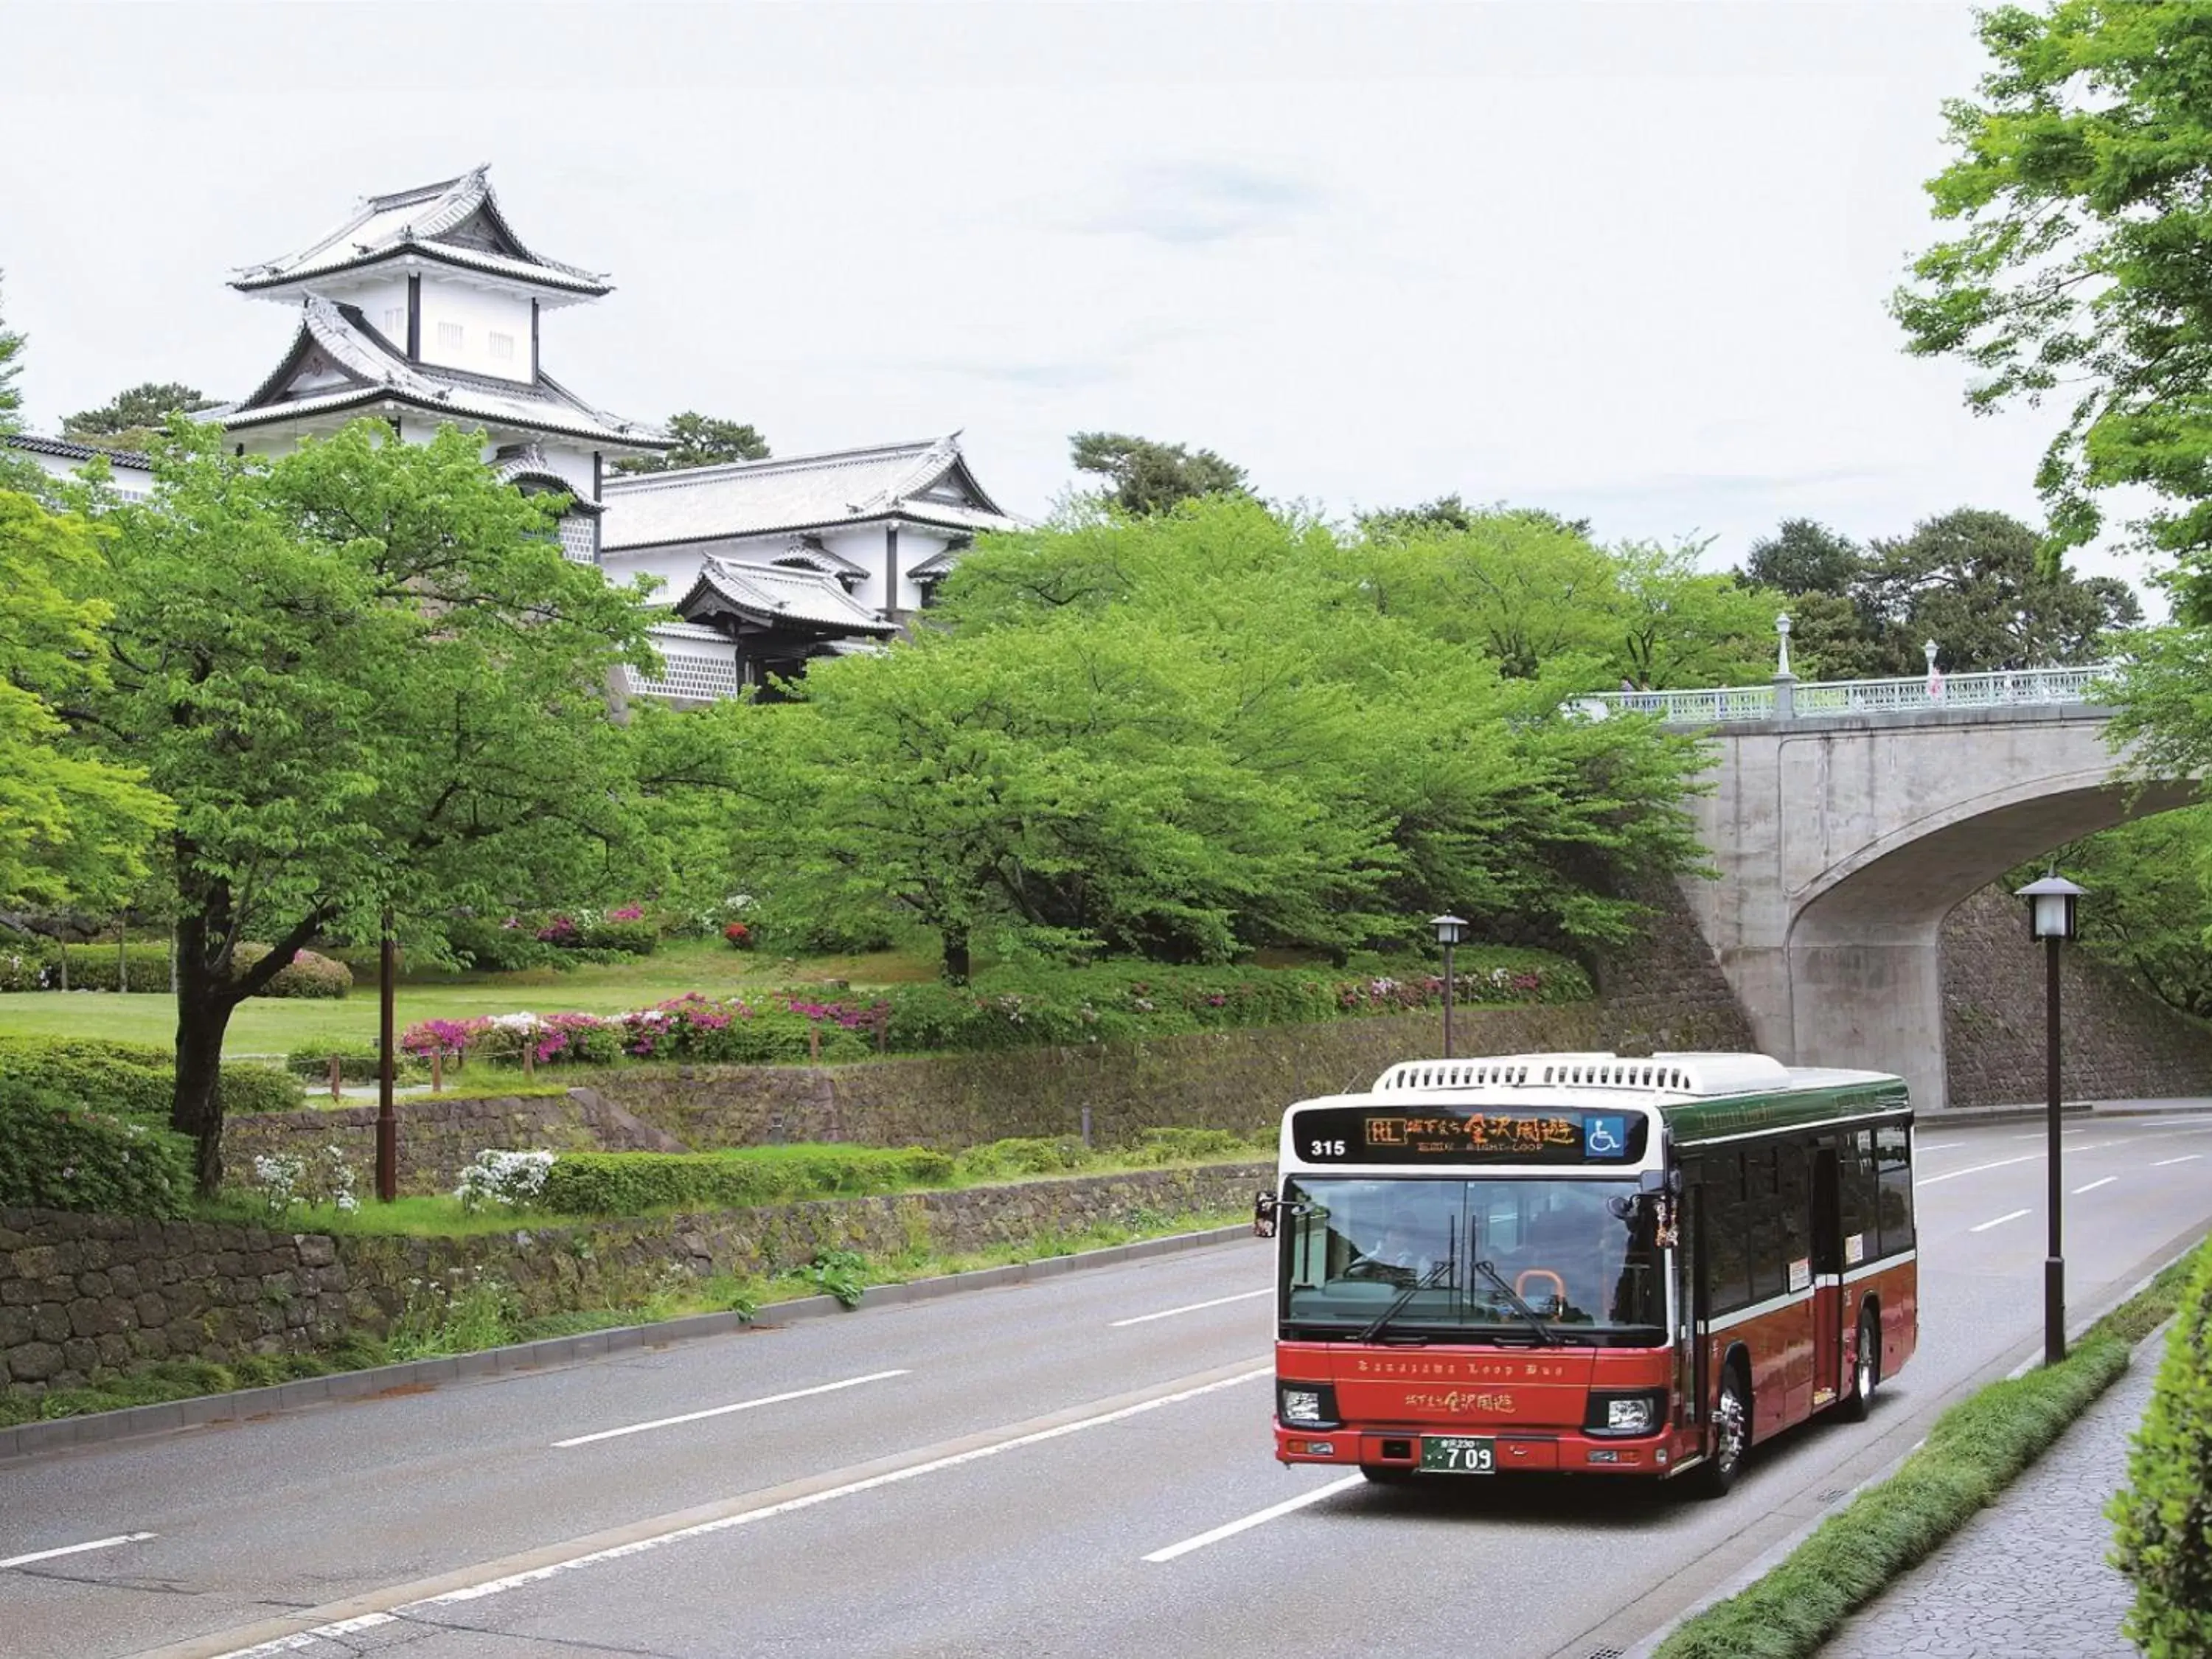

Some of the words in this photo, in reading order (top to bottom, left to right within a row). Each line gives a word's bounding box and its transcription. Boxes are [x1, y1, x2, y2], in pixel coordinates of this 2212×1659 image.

[1371, 1120, 1402, 1143] RL
[1311, 1140, 1346, 1156] 315
[1467, 1363, 1513, 1377] Loop
[1526, 1364, 1563, 1377] Bus
